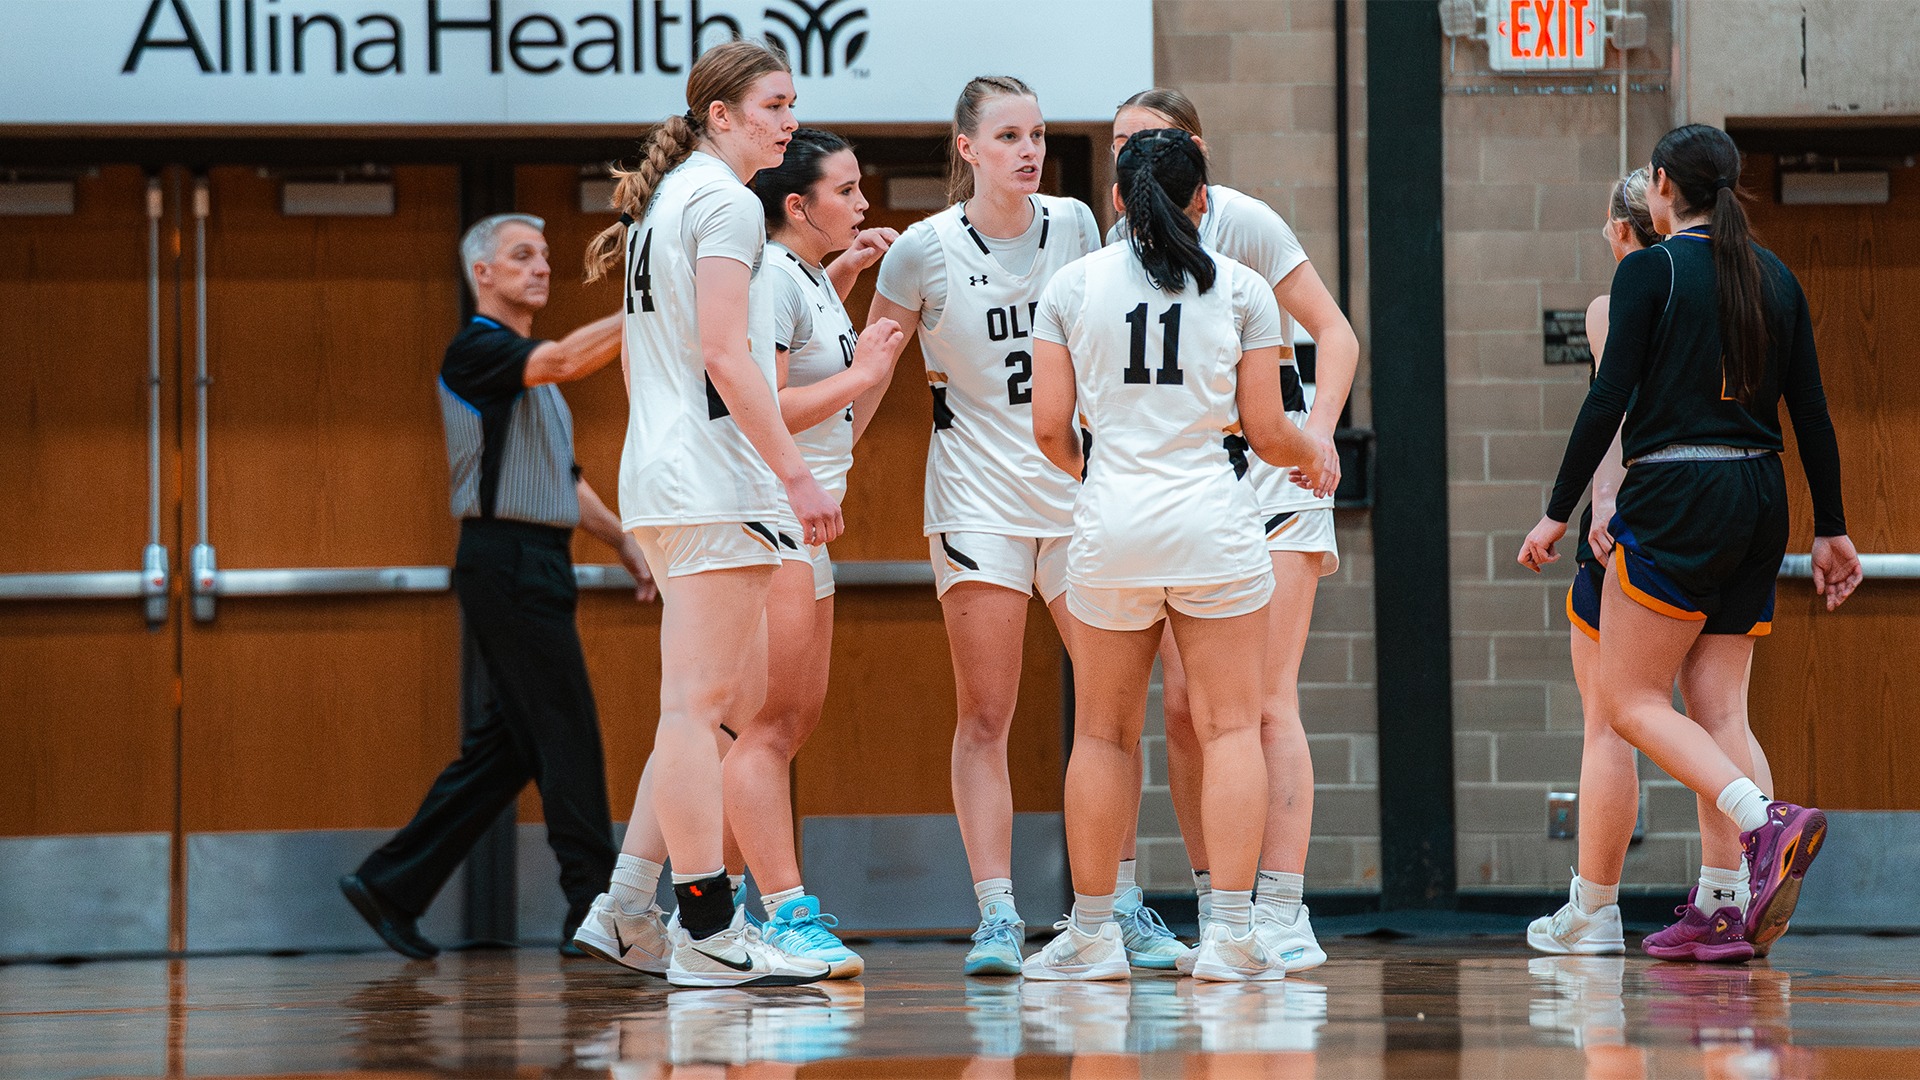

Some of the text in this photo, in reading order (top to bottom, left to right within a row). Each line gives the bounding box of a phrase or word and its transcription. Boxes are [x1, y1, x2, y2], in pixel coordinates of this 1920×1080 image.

[121, 0, 742, 75] Allina Health
[1510, 0, 1589, 58] EXIT
[626, 227, 655, 314] 14
[1123, 302, 1184, 385] 11
